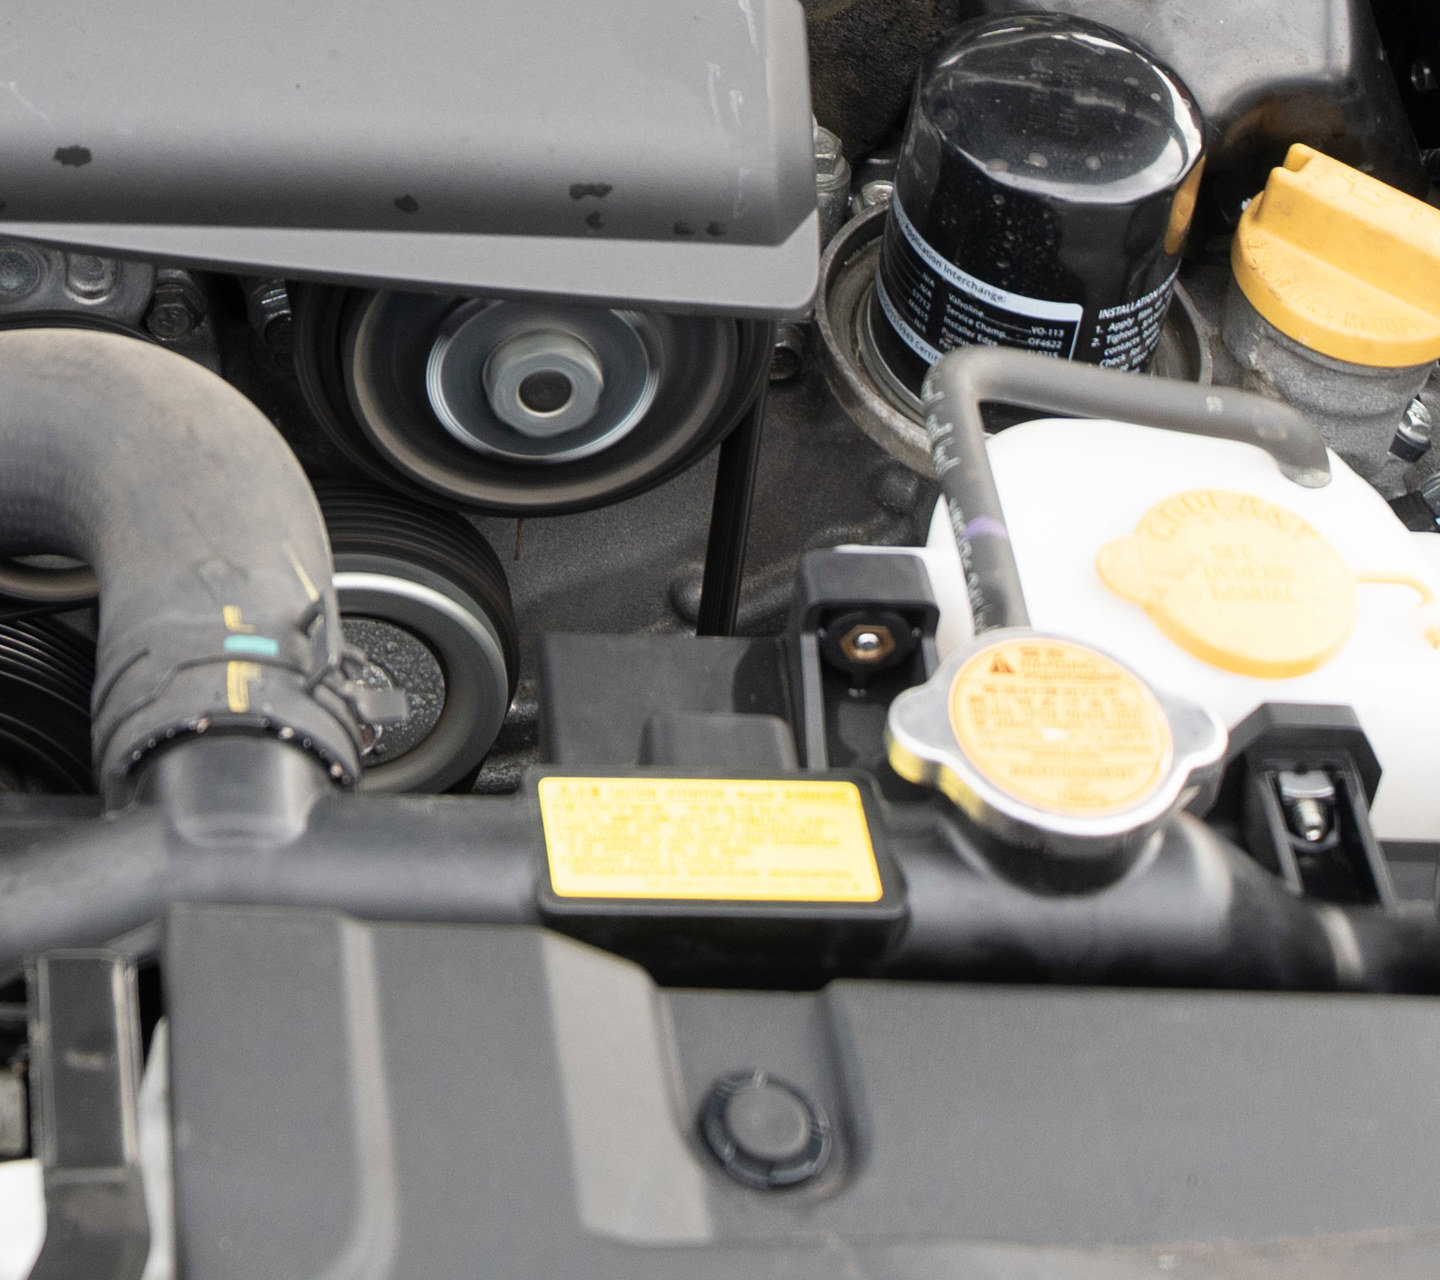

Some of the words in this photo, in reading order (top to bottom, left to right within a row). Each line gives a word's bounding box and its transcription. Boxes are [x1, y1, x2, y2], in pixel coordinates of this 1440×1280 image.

[905, 223, 942, 268] Application
[944, 265, 1007, 302] Interchange:
[943, 316, 976, 338] Installer
[977, 334, 998, 349] Edge
[946, 304, 975, 326] Service
[948, 292, 984, 318] Valvoline
[1031, 326, 1065, 338] VO-113
